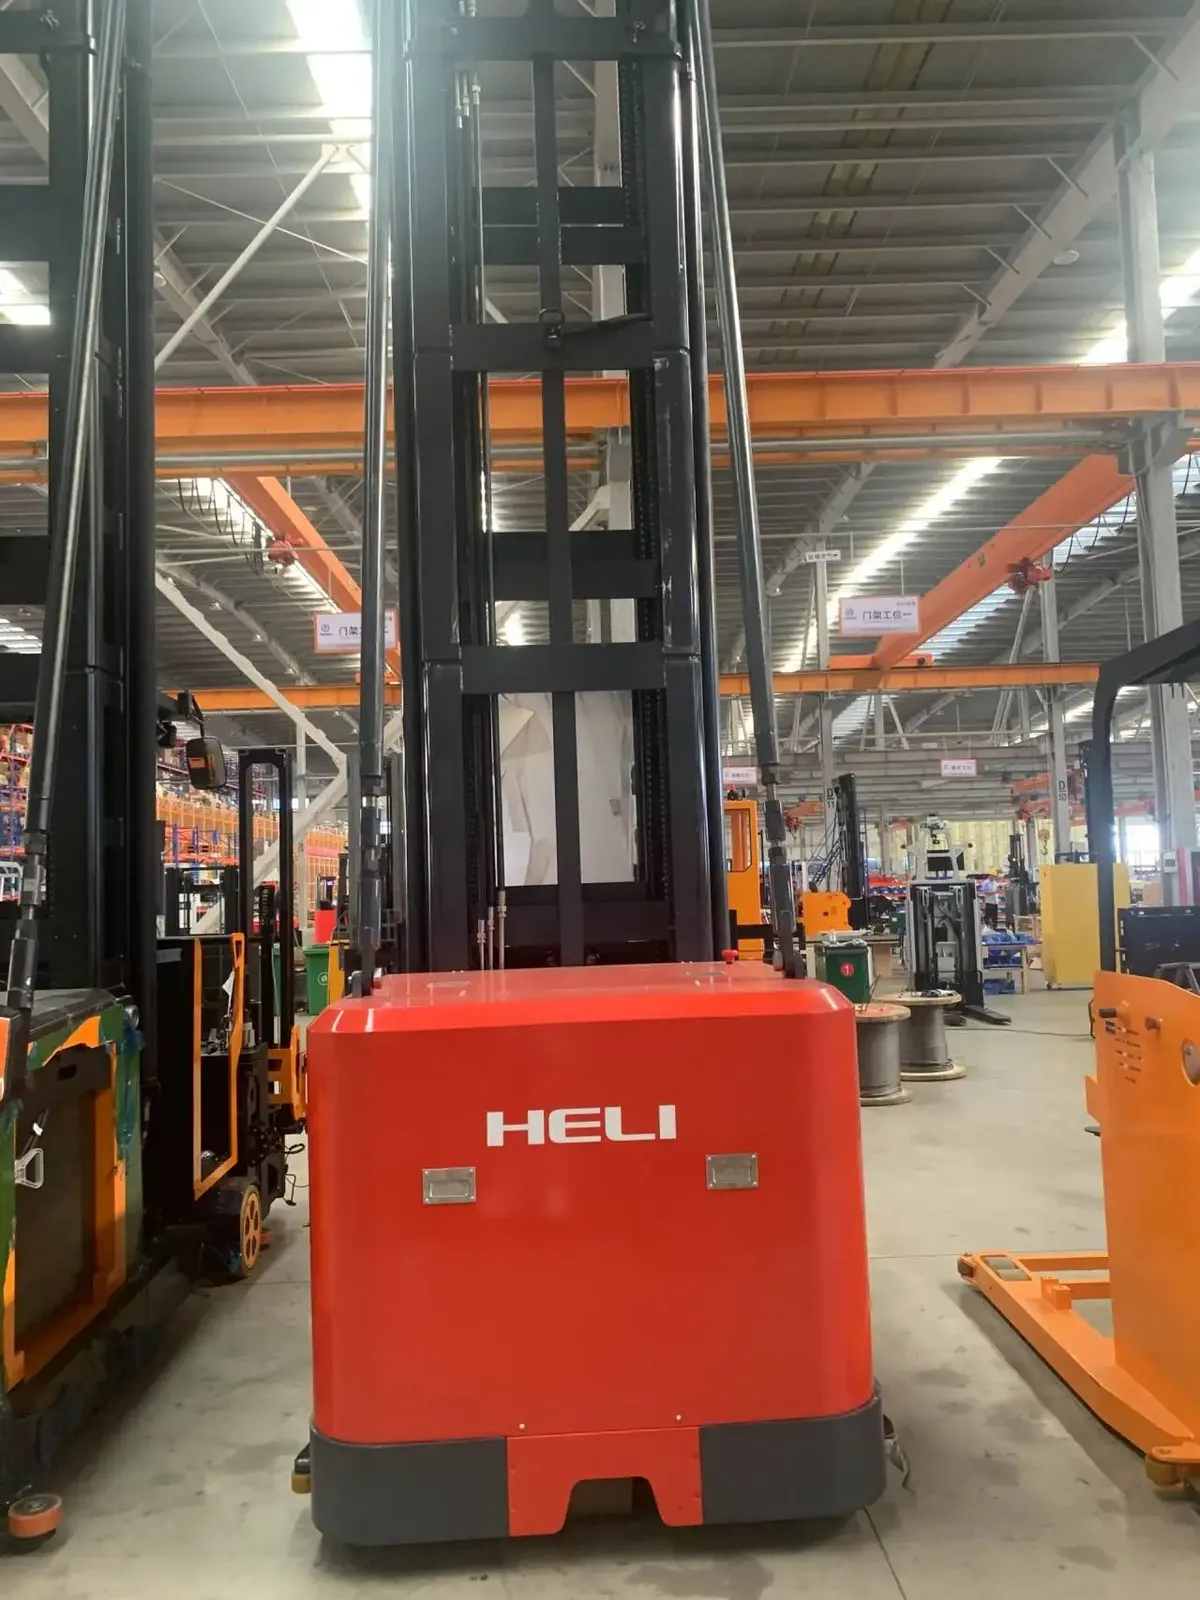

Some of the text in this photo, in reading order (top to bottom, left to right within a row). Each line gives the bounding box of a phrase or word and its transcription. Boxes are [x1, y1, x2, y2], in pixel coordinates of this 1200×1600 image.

[862, 610, 912, 621] 门架工位一
[1058, 780, 1066, 790] D
[826, 788, 834, 797] D
[1058, 793, 1067, 801] 10
[486, 1104, 677, 1147] HELI
